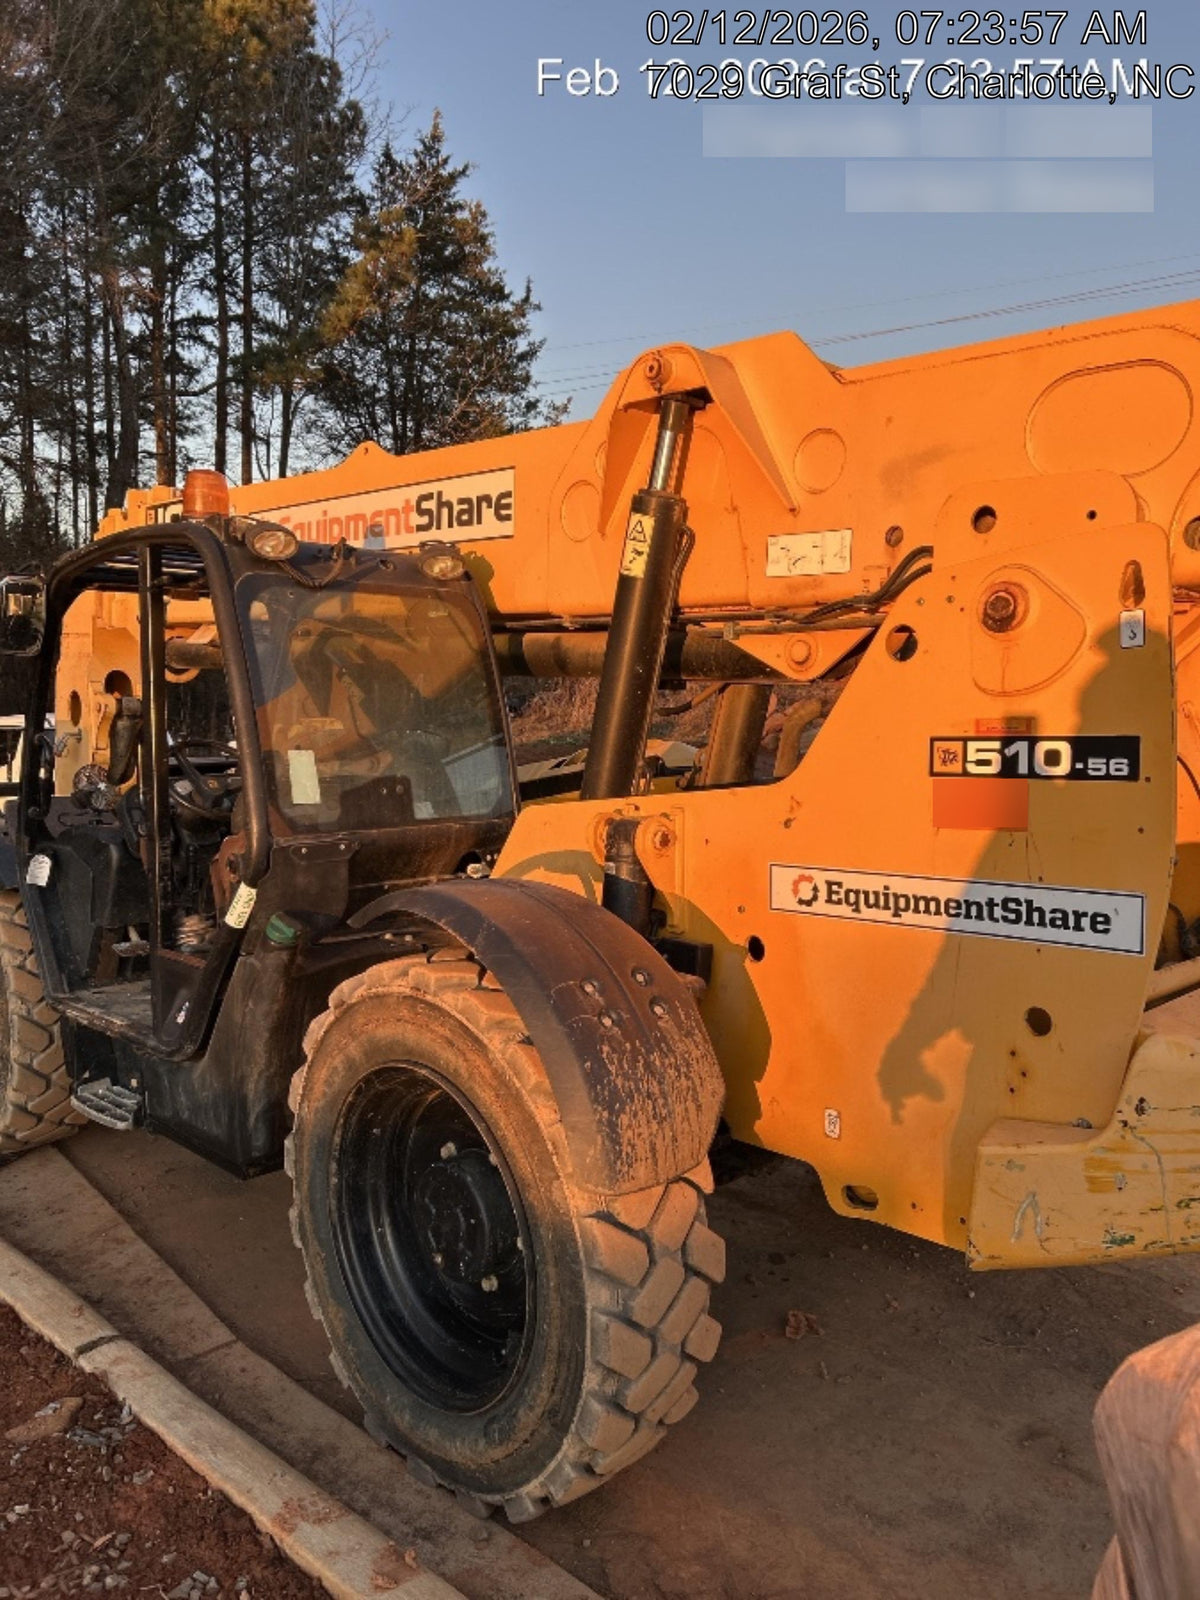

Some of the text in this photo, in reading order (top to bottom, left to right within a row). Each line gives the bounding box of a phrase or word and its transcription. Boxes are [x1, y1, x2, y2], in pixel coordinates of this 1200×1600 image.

[279, 490, 513, 542] quipmentShare
[964, 740, 1130, 777] 510-56
[824, 879, 1113, 936] EquipmentShare
